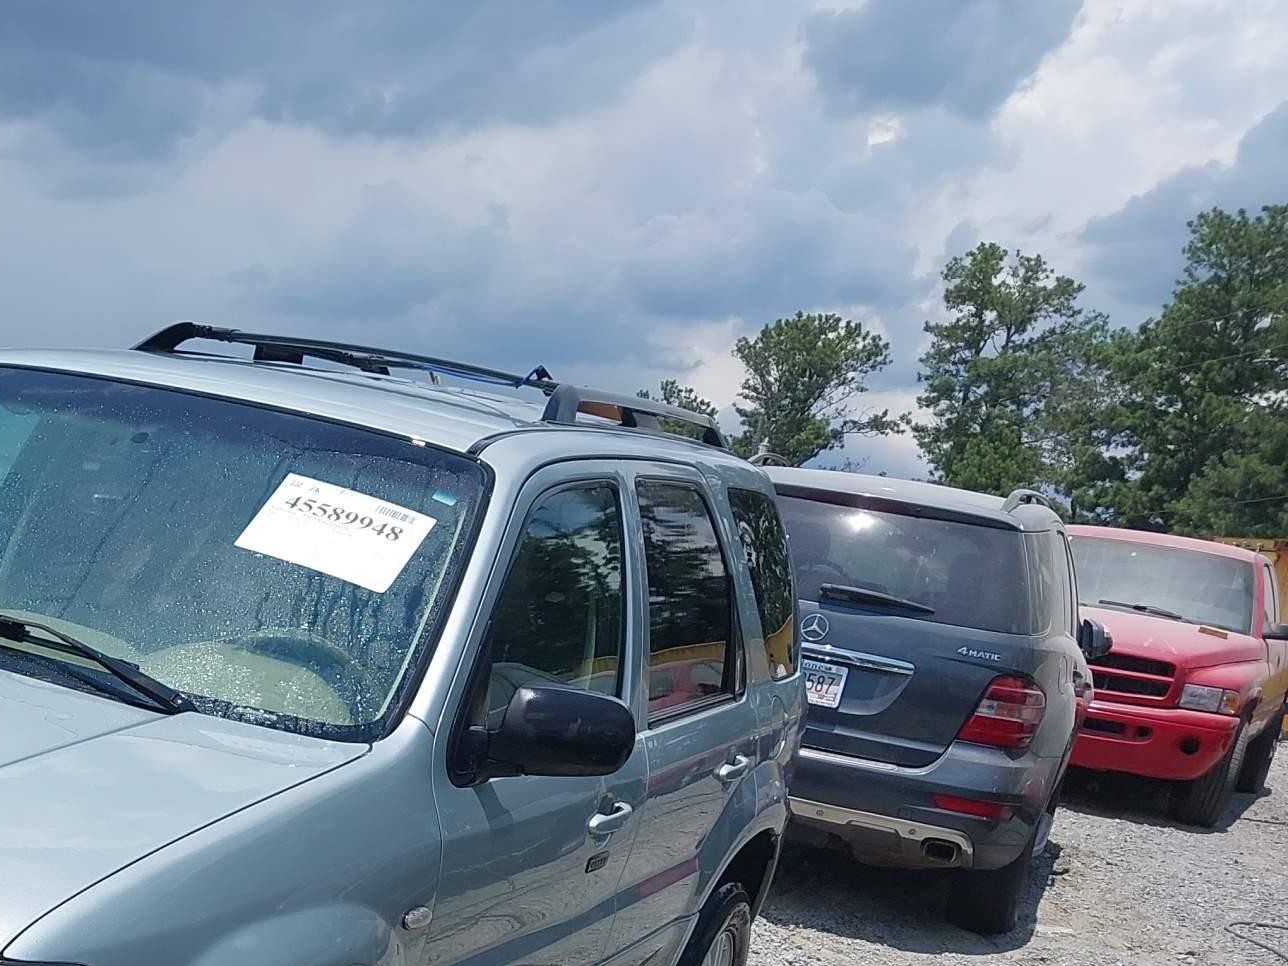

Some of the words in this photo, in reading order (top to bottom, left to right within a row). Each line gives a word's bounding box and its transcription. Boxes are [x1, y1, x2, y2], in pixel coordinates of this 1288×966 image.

[285, 496, 404, 541] 45589948
[957, 646, 1001, 661] 4MATIC
[803, 671, 836, 694] 587
